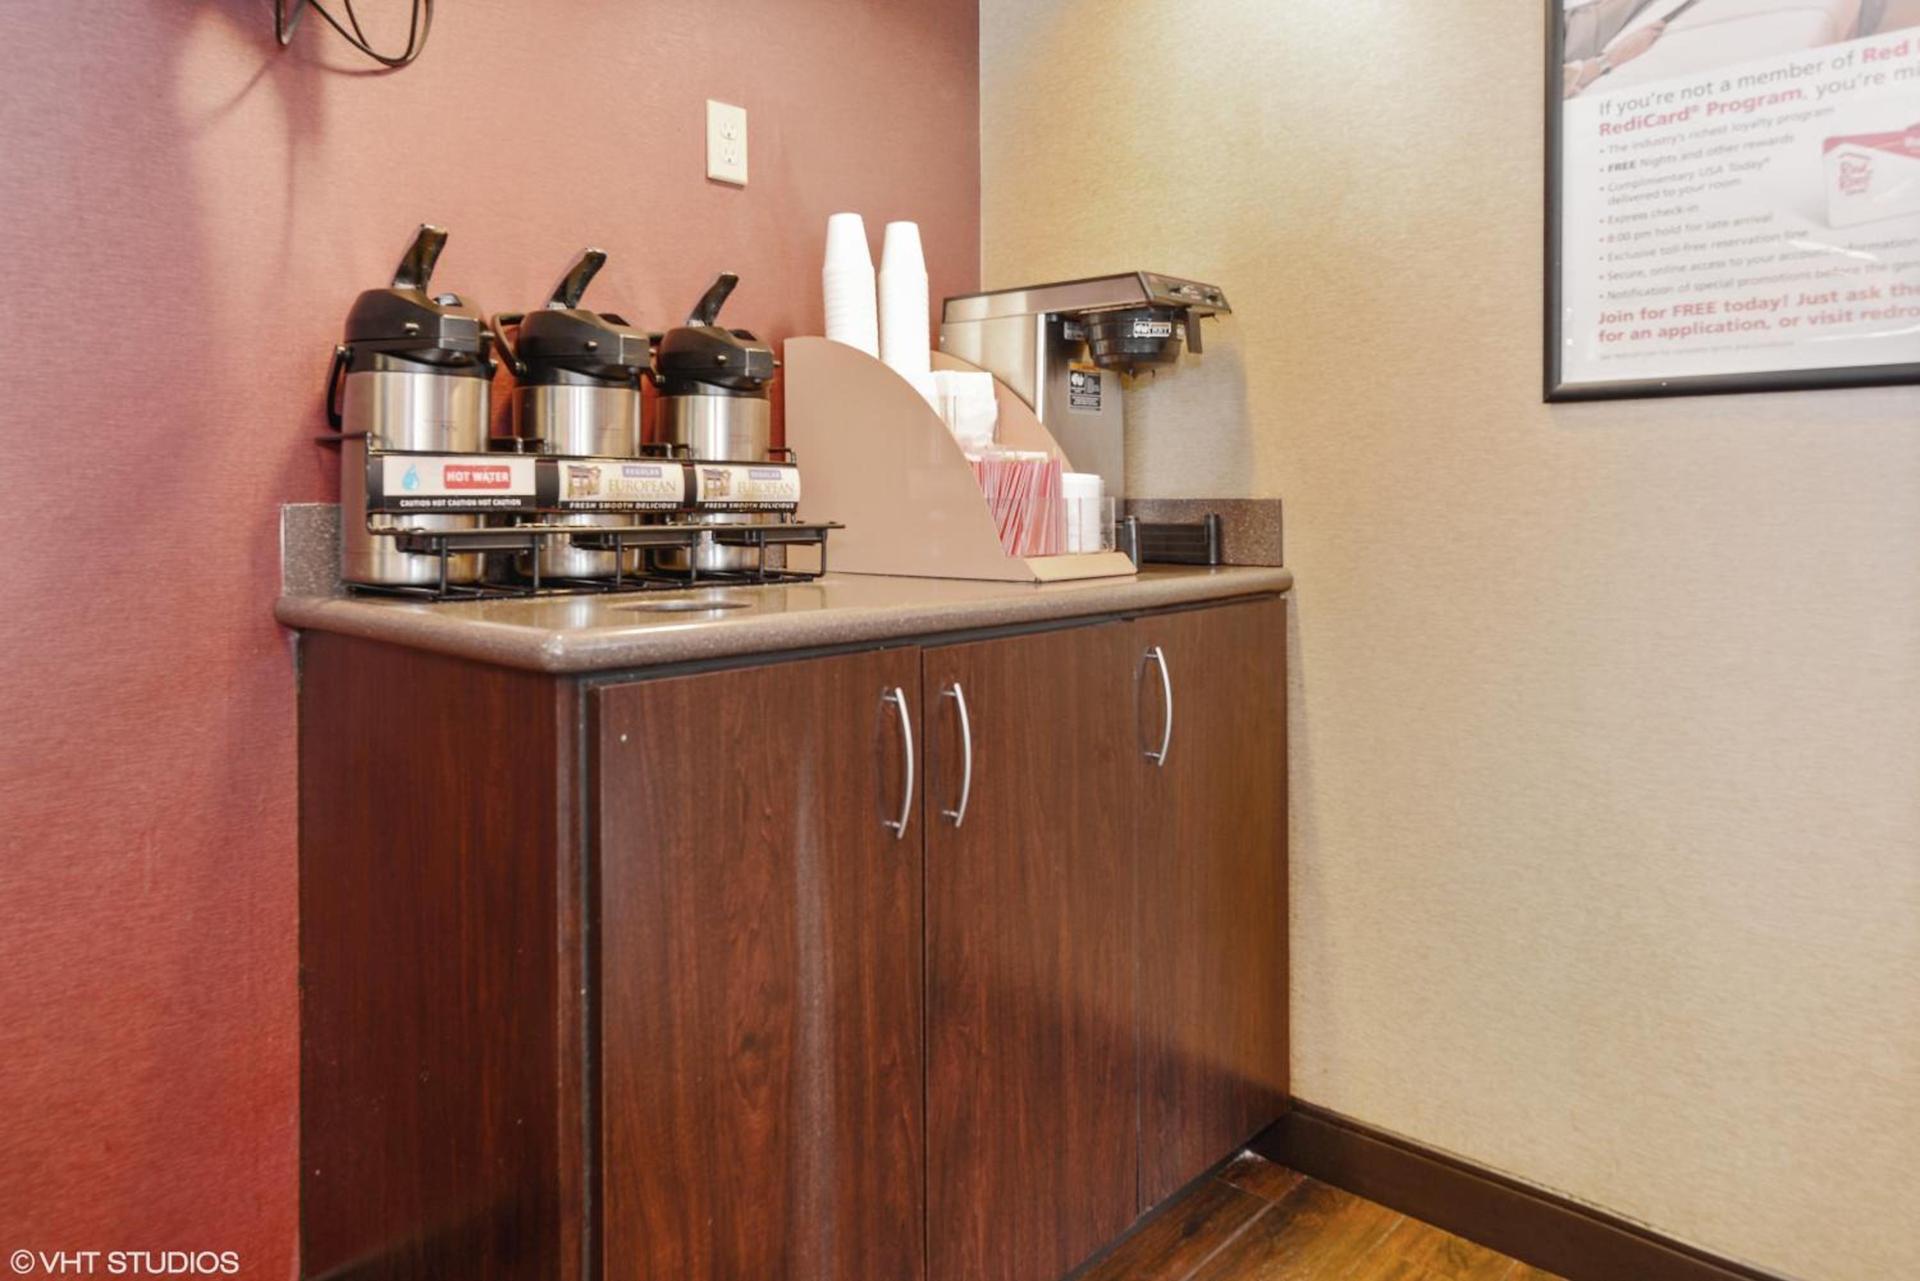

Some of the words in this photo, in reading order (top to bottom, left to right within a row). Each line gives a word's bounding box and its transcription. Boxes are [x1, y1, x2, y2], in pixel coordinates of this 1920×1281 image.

[1600, 99, 1611, 116] If
[1617, 91, 1675, 116] you're
[1681, 82, 1713, 100] not
[1720, 79, 1731, 93] a
[1738, 62, 1824, 90] member
[1831, 50, 1855, 71] of
[1862, 37, 1909, 64] Red
[1816, 71, 1886, 100] you're
[1608, 143, 1628, 155] The
[1731, 115, 1774, 134] loyalty
[1607, 160, 1637, 173] FREE
[1639, 153, 1678, 169] Nights
[1681, 148, 1703, 161] and
[1742, 133, 1795, 149] rewards
[1607, 171, 1695, 192] Complimentary
[1698, 164, 1724, 177] USA
[1663, 187, 1677, 198] to
[1679, 184, 1705, 198] your
[1607, 211, 1649, 225] Express
[1655, 224, 1683, 237] hold
[1685, 221, 1703, 232] for
[1705, 218, 1729, 230] late
[1733, 213, 1773, 227] arrival
[1607, 248, 1657, 263] Exclusive
[1711, 232, 1781, 249] reservation
[1650, 263, 1687, 277] online
[1690, 260, 1727, 272] access
[1729, 256, 1743, 266] to
[1746, 253, 1775, 268] your
[1607, 284, 1675, 300] Notification
[1678, 282, 1691, 293] of
[1694, 276, 1735, 293] special
[1737, 270, 1812, 290] promotions
[1598, 309, 1634, 326] Join
[1639, 306, 1667, 321] for
[1672, 300, 1717, 317] FREE
[1723, 293, 1789, 313] today!
[1796, 290, 1839, 307] Just
[1846, 284, 1882, 301] ask
[1598, 328, 1625, 343] for
[1629, 328, 1653, 341] an
[1657, 317, 1771, 340] application,
[1778, 315, 1801, 328] or
[1807, 308, 1854, 326] visit
[446, 470, 470, 483] HOT
[472, 471, 510, 484] WATER
[608, 478, 677, 493] EUROPEAN
[737, 480, 795, 494] EUROPEAN
[400, 498, 431, 508] CAUTION
[569, 501, 598, 510] FRESH
[599, 501, 634, 510] SMOOTH
[635, 501, 678, 510] DELICIOUS
[704, 502, 728, 510] FRESH
[759, 502, 795, 510] DELICIOUS
